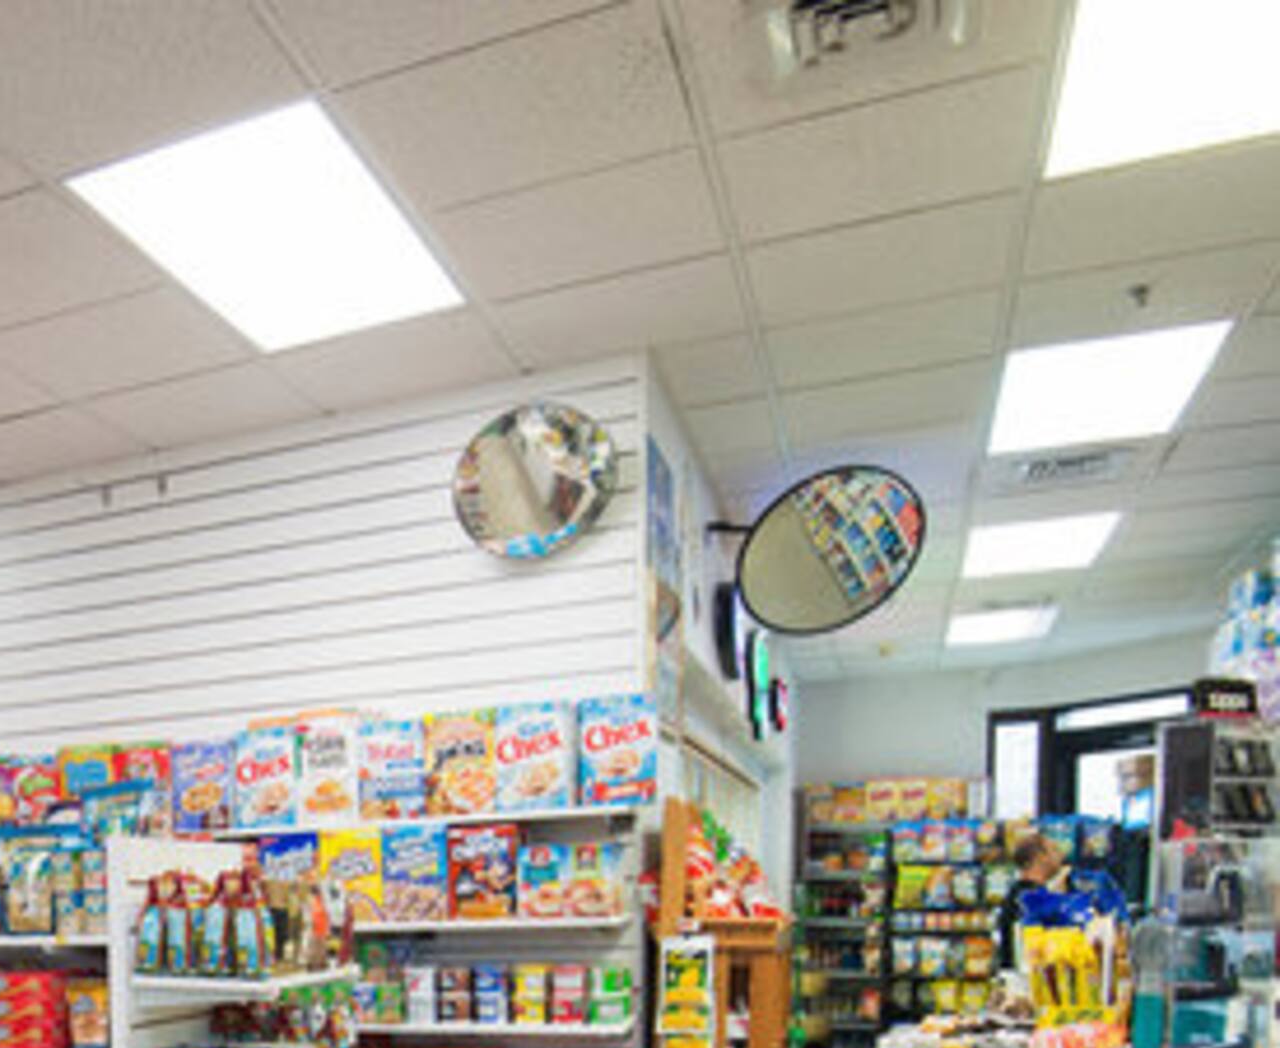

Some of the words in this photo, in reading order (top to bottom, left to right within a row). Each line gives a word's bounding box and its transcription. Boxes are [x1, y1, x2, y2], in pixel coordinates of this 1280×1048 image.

[496, 729, 562, 765] Chex
[585, 719, 652, 752] Chex
[236, 752, 290, 786] Chex
